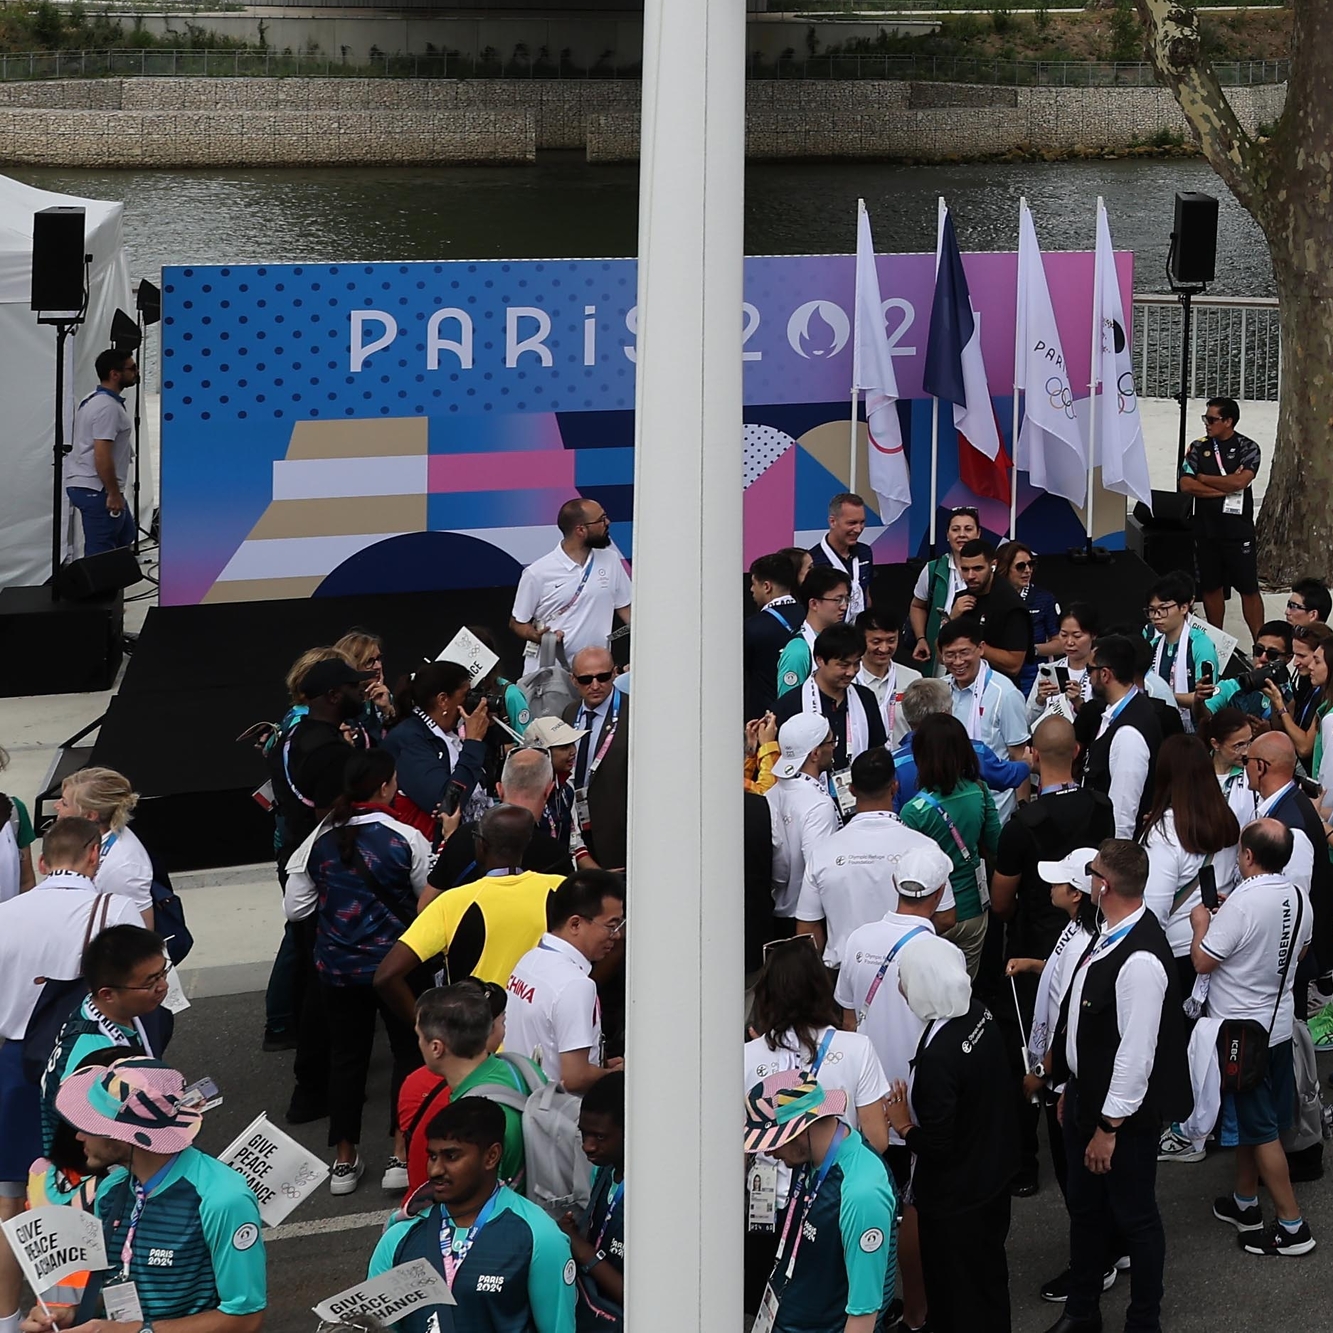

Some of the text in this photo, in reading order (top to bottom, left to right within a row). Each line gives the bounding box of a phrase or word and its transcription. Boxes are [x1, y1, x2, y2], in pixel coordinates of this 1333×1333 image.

[1276, 899, 1291, 976] ARGENTINA
[1229, 1039, 1239, 1062] ICBC
[247, 1133, 278, 1159] GIVE
[234, 1148, 273, 1179] PEACE
[15, 1218, 43, 1244] GIVE
[24, 1232, 58, 1261] PEACE
[34, 1246, 88, 1280] A CHANCE
[148, 1257, 173, 1266] 2024
[476, 1283, 502, 1293] 2024
[329, 1291, 369, 1316] GIVE
